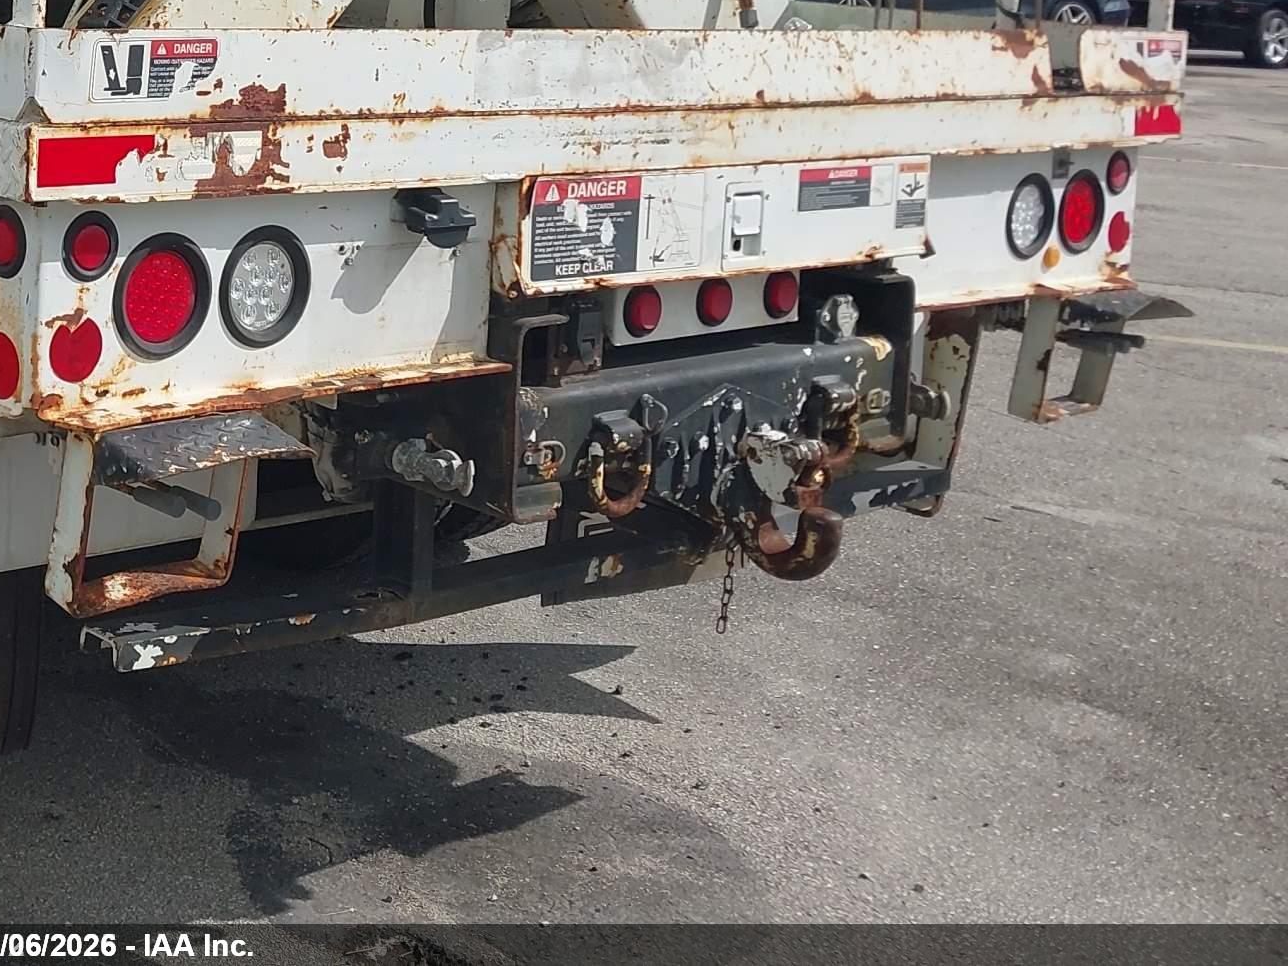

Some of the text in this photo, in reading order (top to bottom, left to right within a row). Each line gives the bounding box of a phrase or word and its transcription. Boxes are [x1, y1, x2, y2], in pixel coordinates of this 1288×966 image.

[173, 43, 213, 54] DANGER
[568, 180, 627, 198] DANGER
[555, 260, 614, 276] KEEP CLEAR
